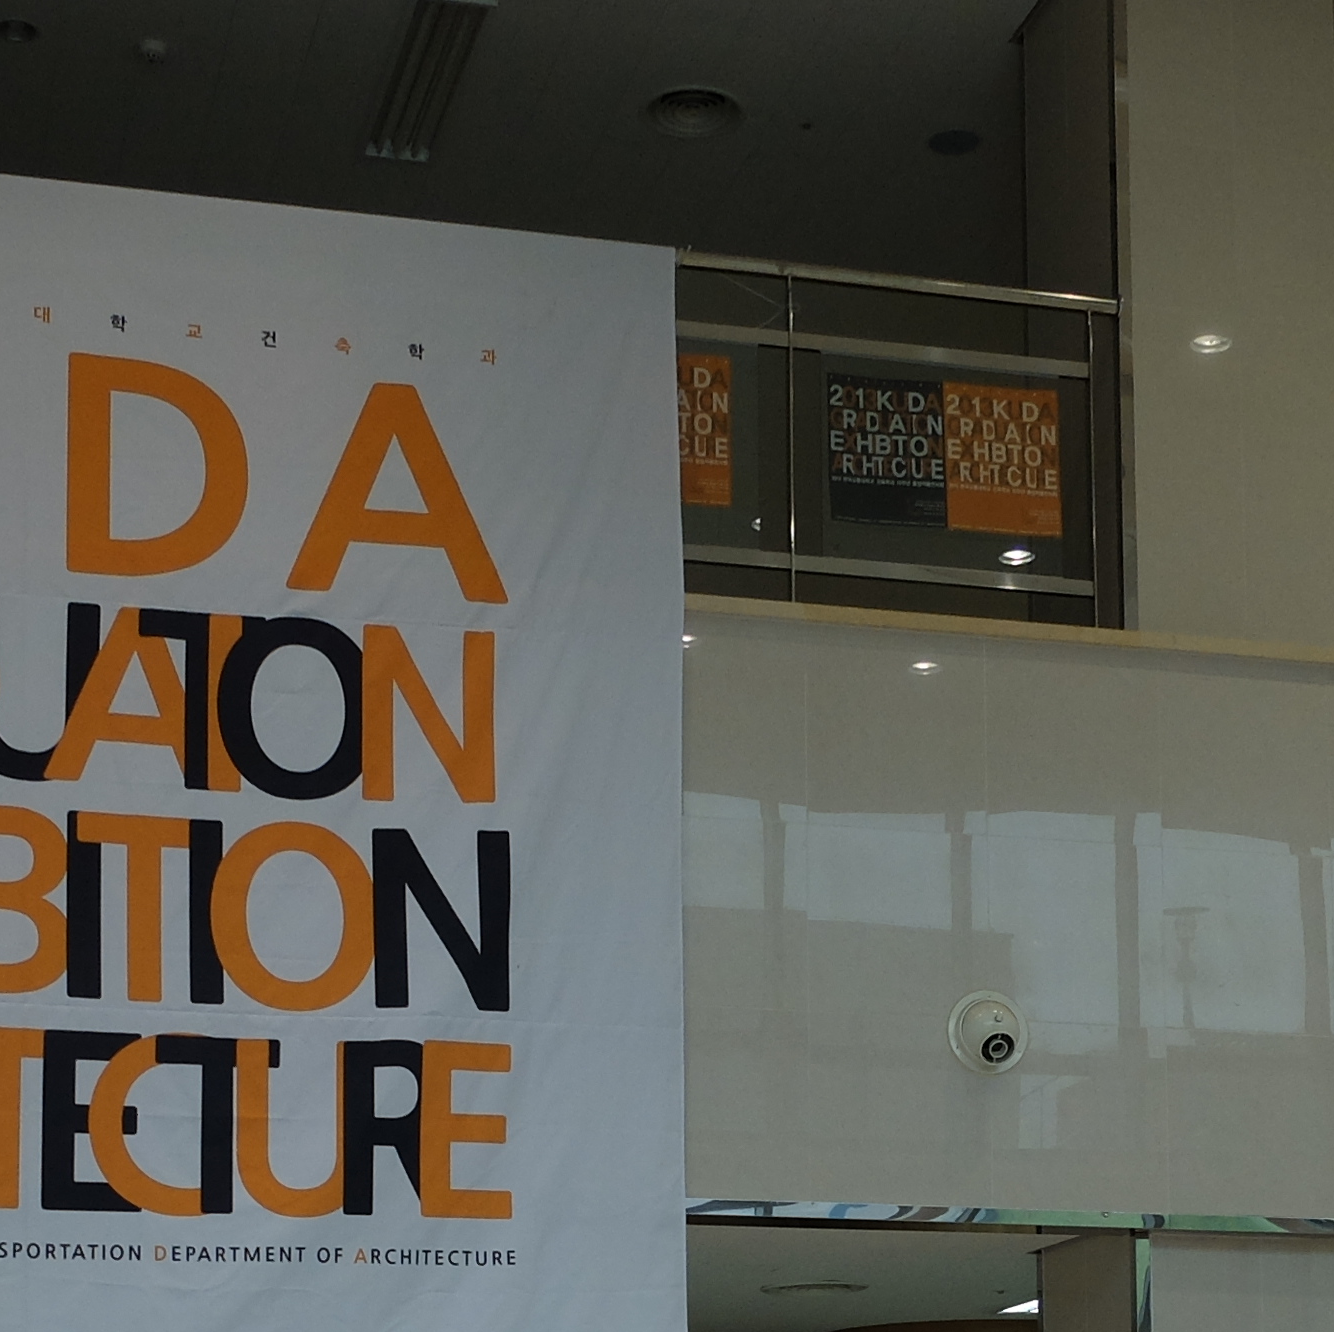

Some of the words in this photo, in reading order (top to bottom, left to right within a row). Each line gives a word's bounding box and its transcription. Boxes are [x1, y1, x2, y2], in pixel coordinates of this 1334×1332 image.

[154, 1245, 307, 1264] DEPARTMENT
[317, 1246, 345, 1265] OF
[354, 1247, 517, 1267] ARCHITECTURE
